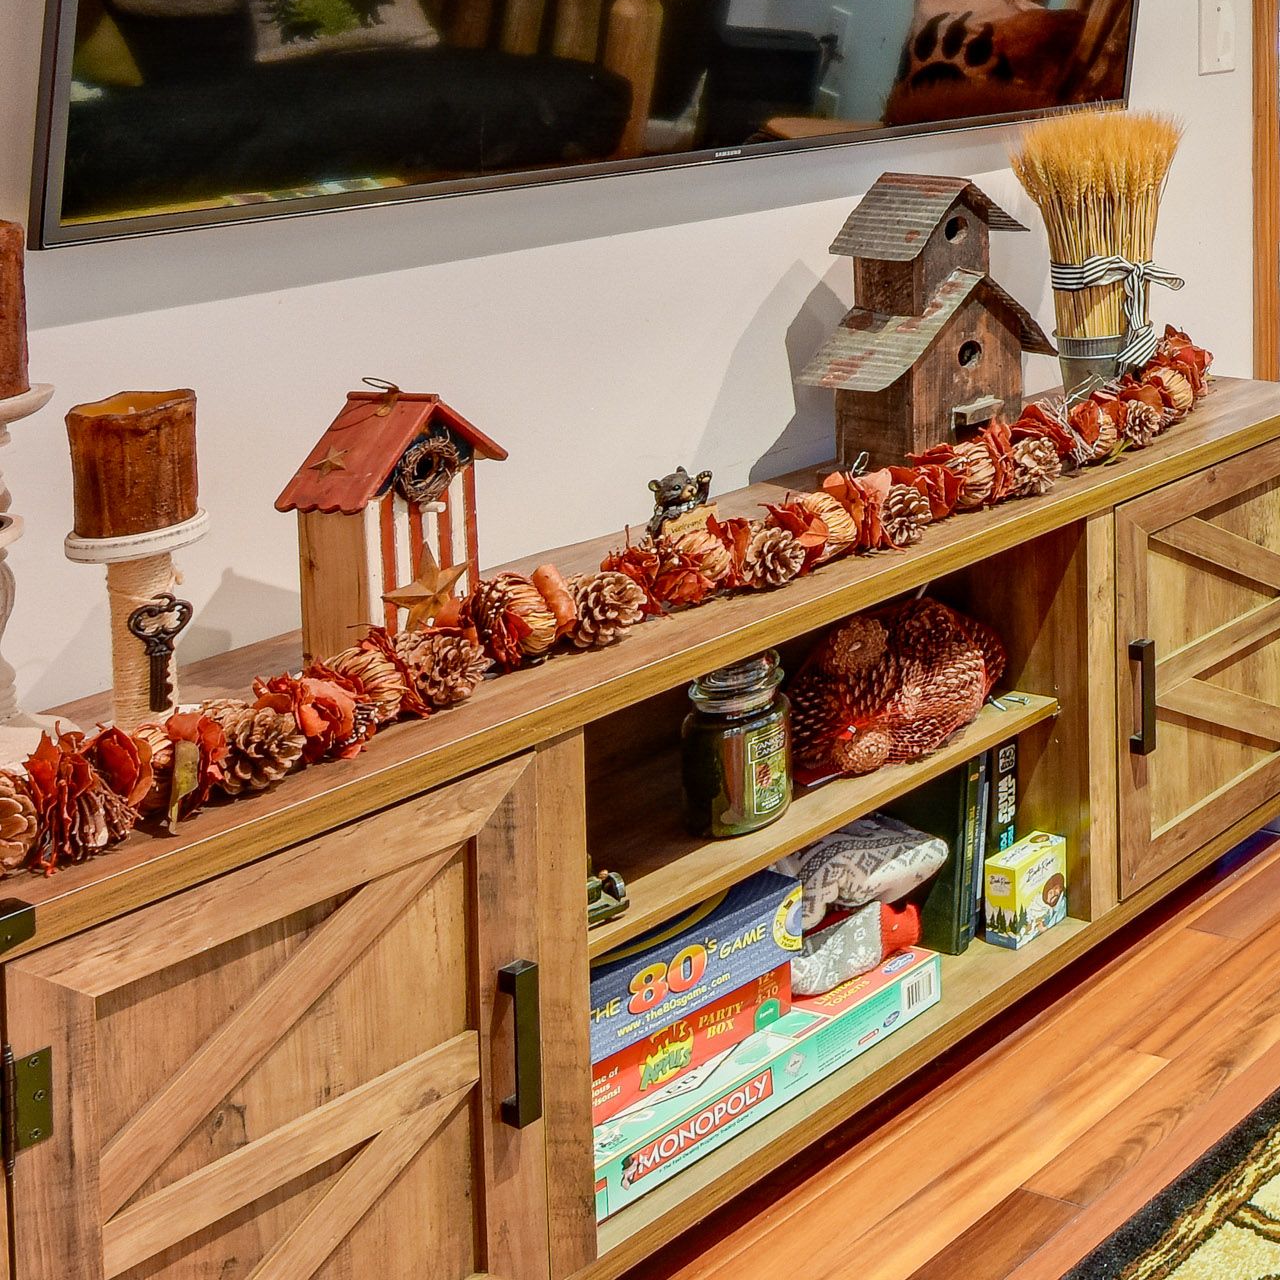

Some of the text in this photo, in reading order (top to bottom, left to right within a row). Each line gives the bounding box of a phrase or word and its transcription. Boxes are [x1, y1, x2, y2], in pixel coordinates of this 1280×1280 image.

[998, 776, 1011, 824] WARS
[1007, 774, 1016, 818] STAR
[591, 996, 621, 1024] THE
[719, 923, 768, 959] GAME
[757, 971, 775, 986] 12+
[616, 971, 731, 1038] www.the80sgame.com
[754, 985, 778, 1005] 4-10
[698, 1001, 745, 1028] PARTY
[706, 1018, 736, 1039] BOX
[592, 1066, 619, 1088] me of
[637, 1075, 768, 1173] MONOPOLY
